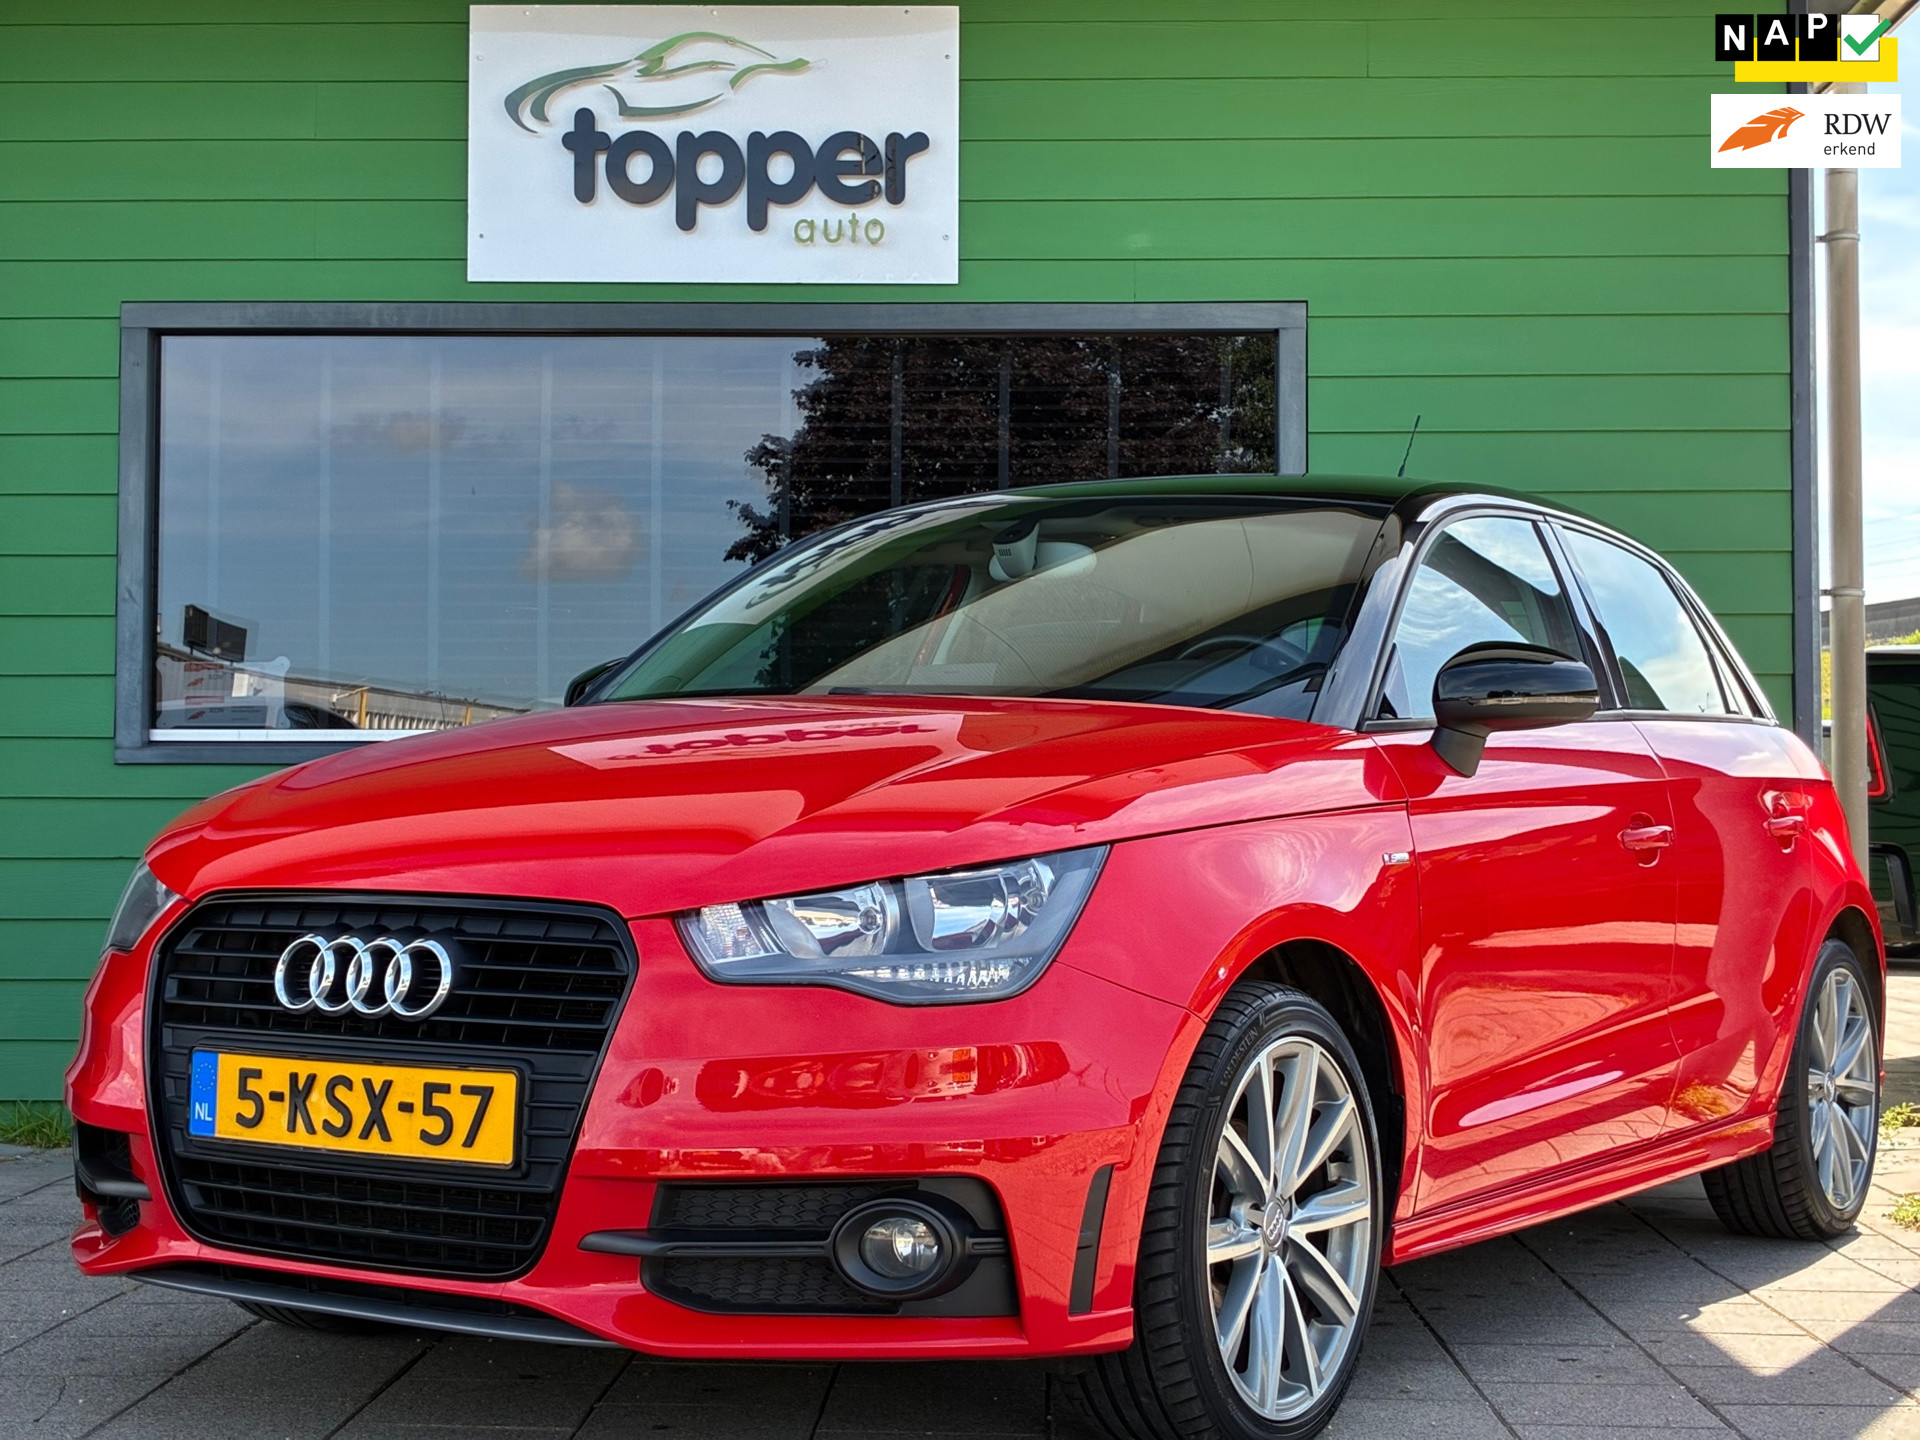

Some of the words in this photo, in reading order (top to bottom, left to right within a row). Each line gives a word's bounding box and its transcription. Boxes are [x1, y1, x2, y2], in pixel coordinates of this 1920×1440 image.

[561, 107, 930, 231] topper
[794, 212, 885, 244] auto
[194, 1102, 213, 1122] NL
[235, 1066, 494, 1148] 5-KSX-57
